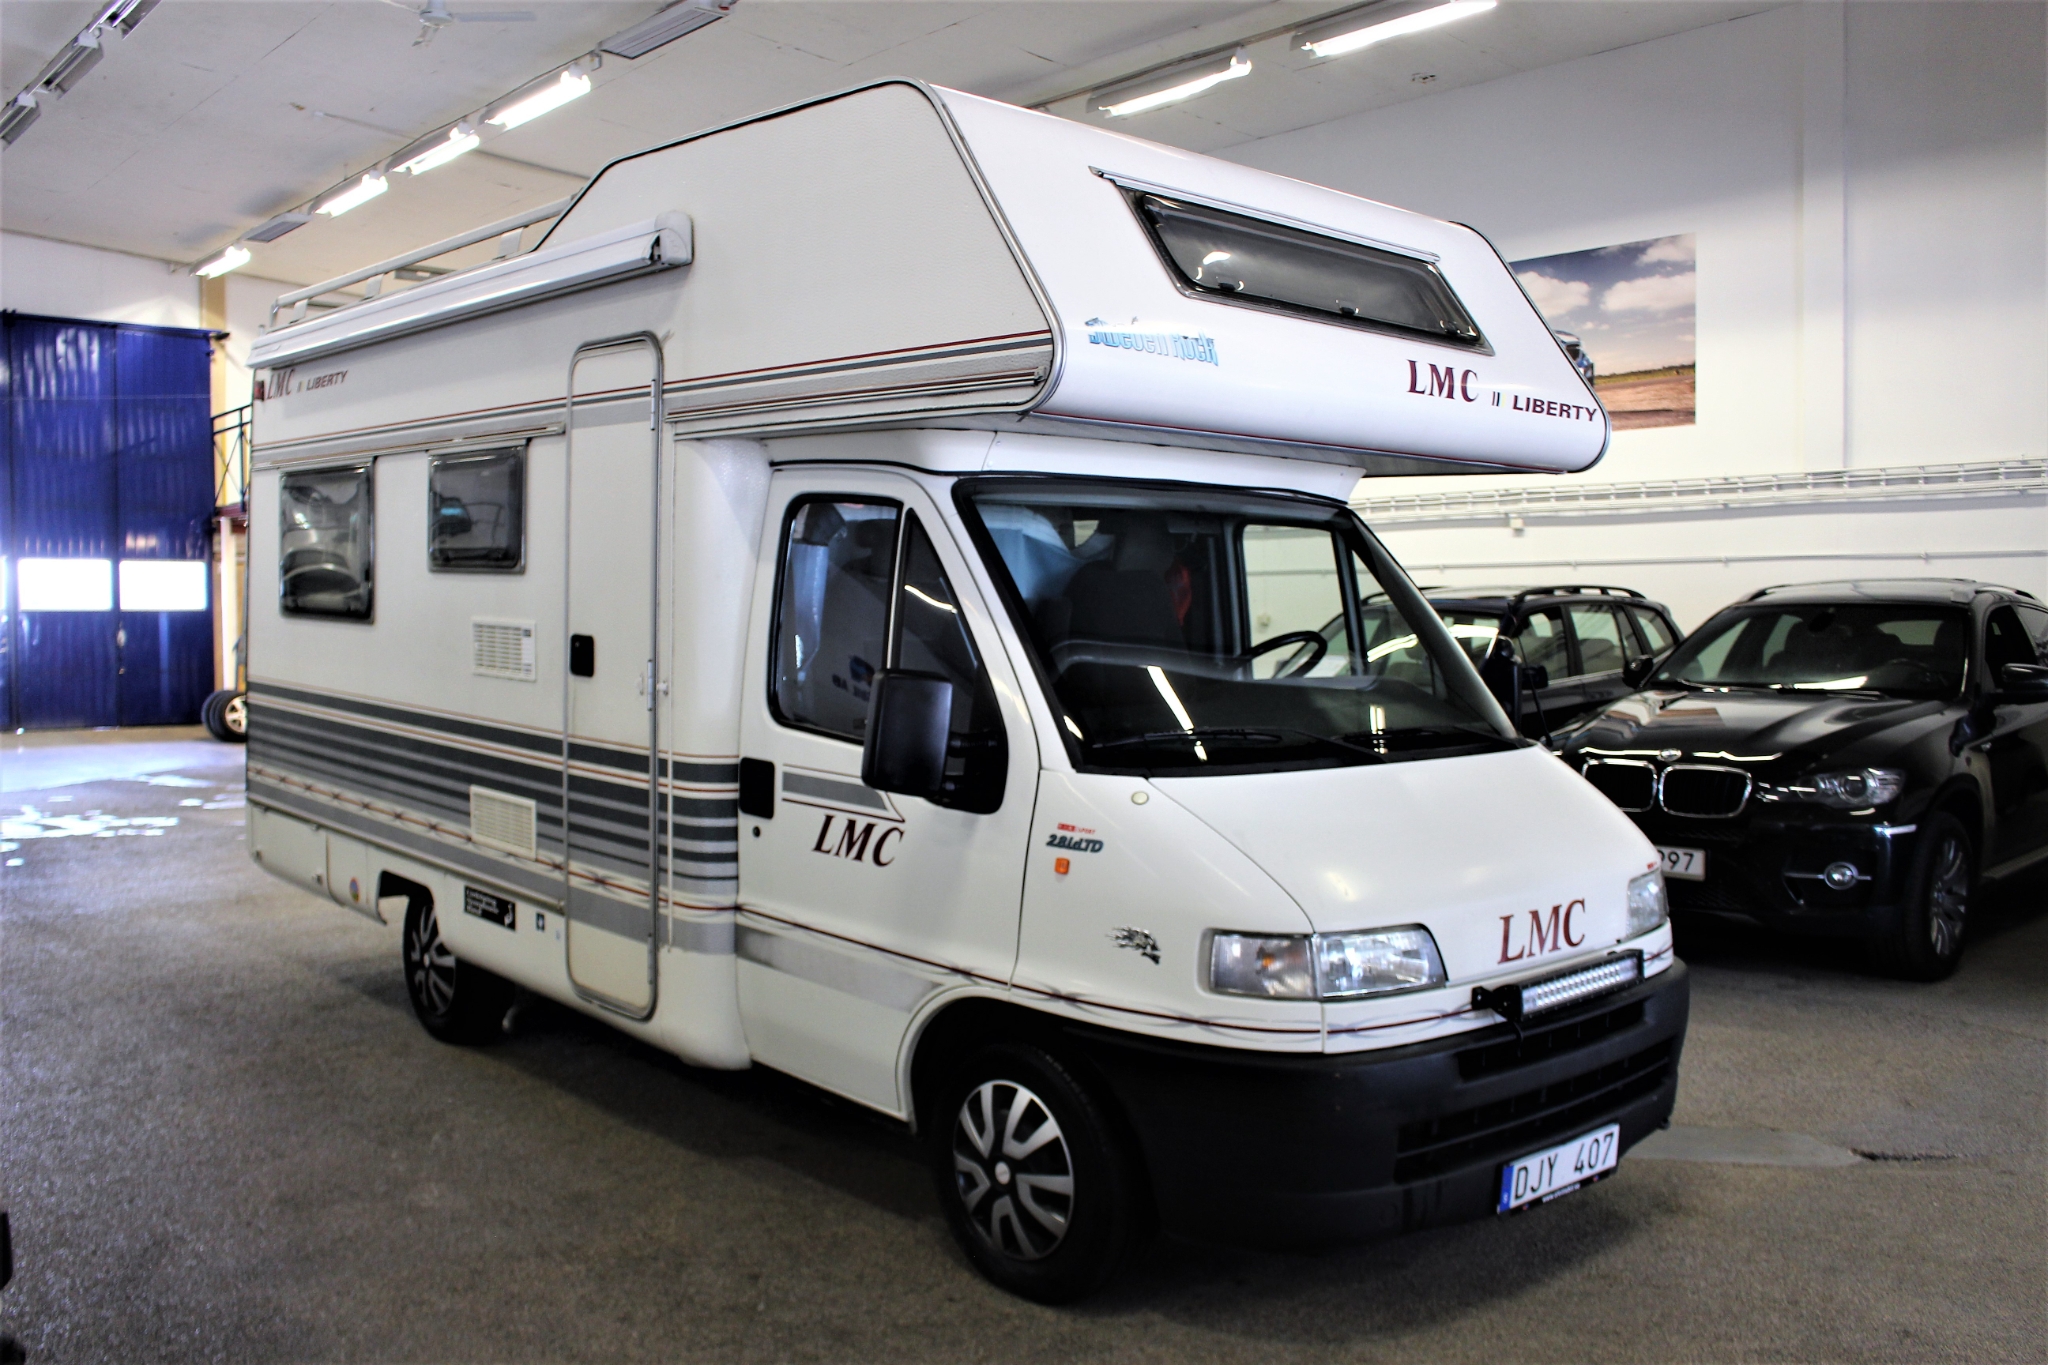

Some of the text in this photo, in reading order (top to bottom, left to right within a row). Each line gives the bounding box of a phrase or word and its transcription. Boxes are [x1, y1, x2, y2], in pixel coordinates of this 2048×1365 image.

[267, 368, 349, 400] LMC LIBERTY
[1406, 359, 1597, 422] LMC LIBERTY
[811, 814, 905, 868] LMC
[1497, 898, 1586, 965] LMC
[1514, 1153, 1558, 1201] DJY
[1574, 1131, 1615, 1174] 407
